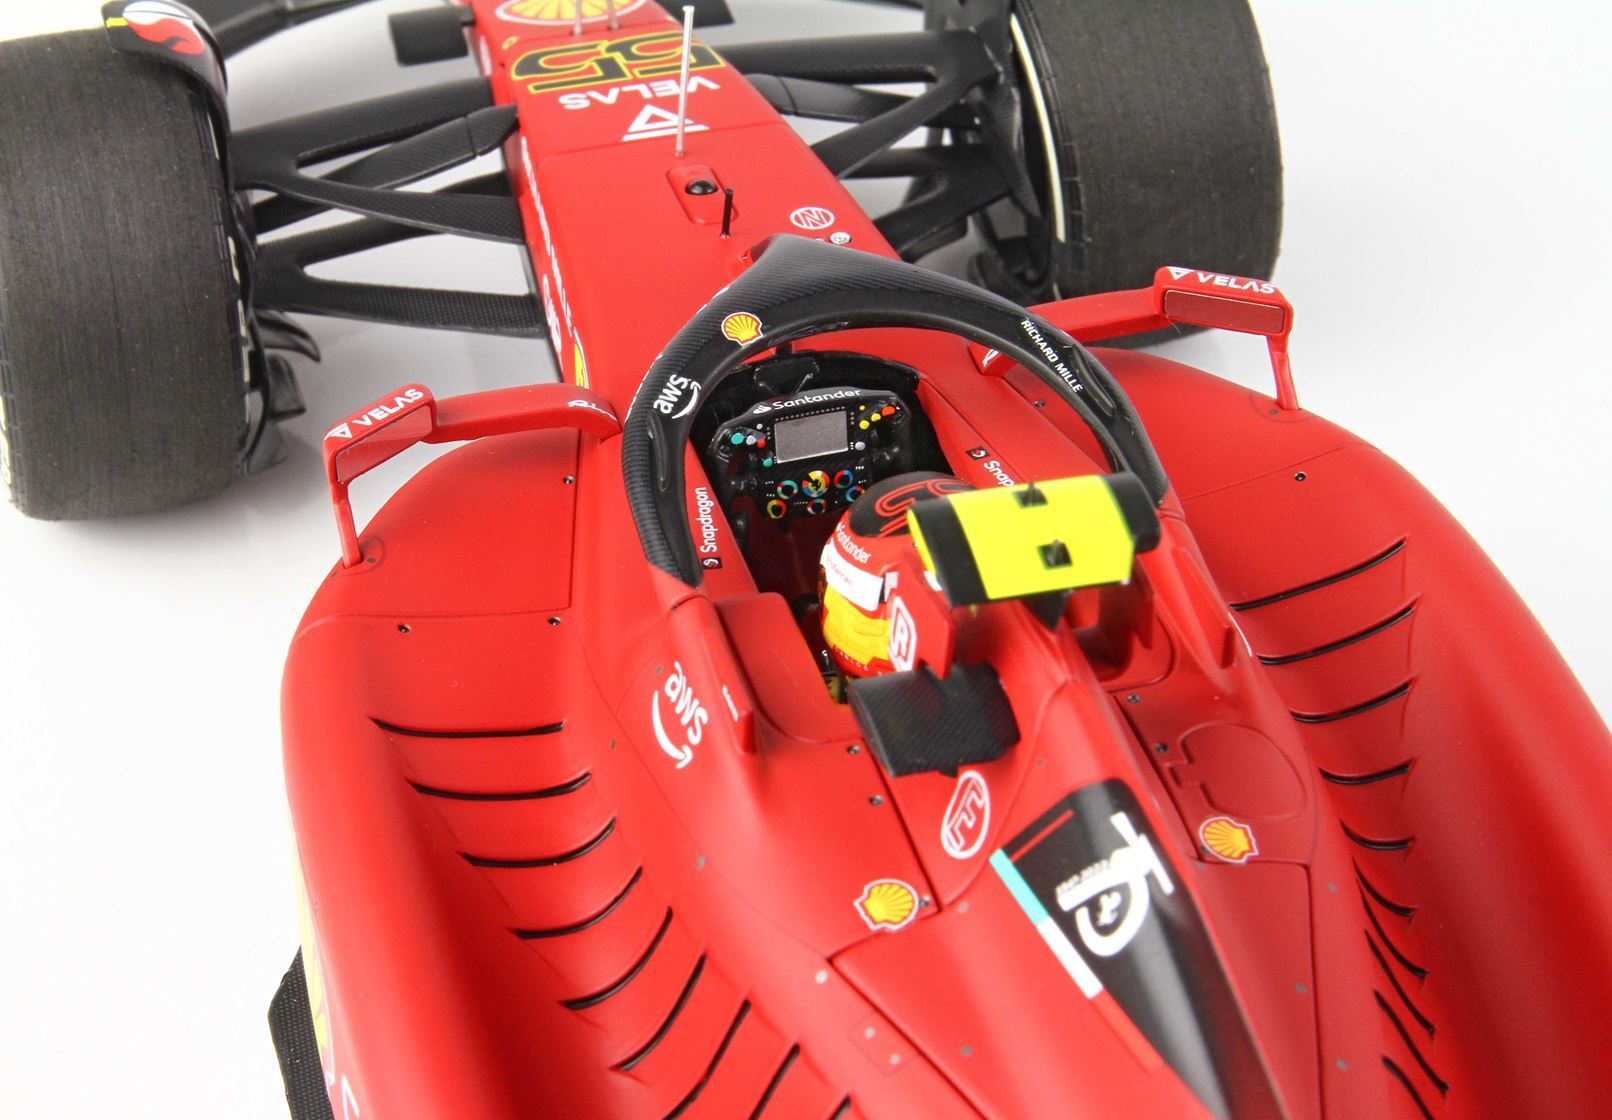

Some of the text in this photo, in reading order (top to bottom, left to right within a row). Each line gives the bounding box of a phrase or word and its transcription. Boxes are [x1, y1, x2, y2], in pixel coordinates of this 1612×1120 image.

[511, 30, 726, 94] 55
[558, 76, 720, 109] VELAS
[1197, 272, 1275, 294] VELAS
[1021, 319, 1083, 393] RICHARD MILLE
[351, 388, 424, 427] VELAS
[653, 374, 690, 414] aws
[772, 388, 862, 411] Santander
[694, 486, 719, 553] Snapdragon
[664, 660, 709, 746] aws
